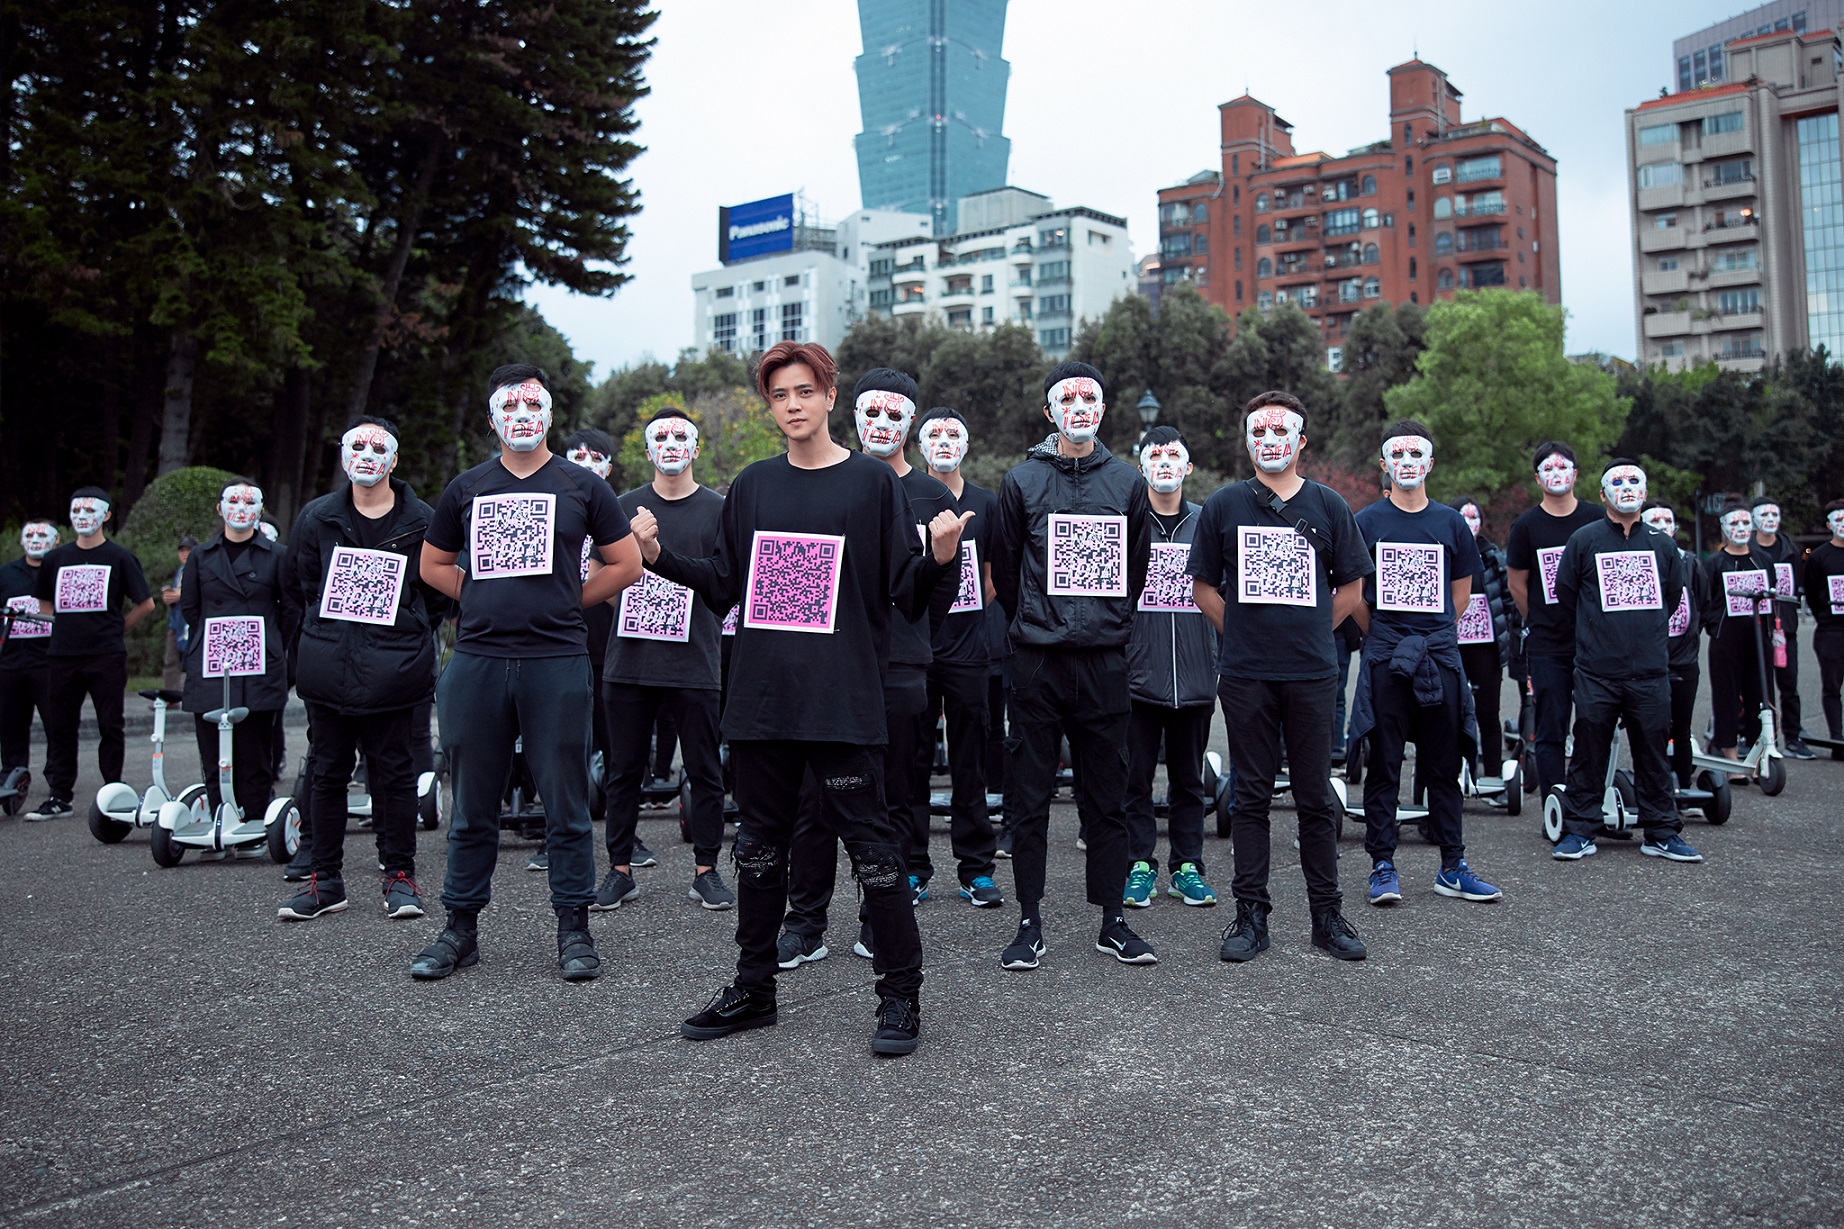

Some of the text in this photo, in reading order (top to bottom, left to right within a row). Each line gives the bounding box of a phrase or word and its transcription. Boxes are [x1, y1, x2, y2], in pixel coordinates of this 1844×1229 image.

[729, 215, 790, 241] Panasonic
[503, 420, 544, 439] IDEA
[1063, 411, 1099, 430] IDEA
[862, 428, 902, 444] IDEA
[1255, 443, 1292, 461] IDEA
